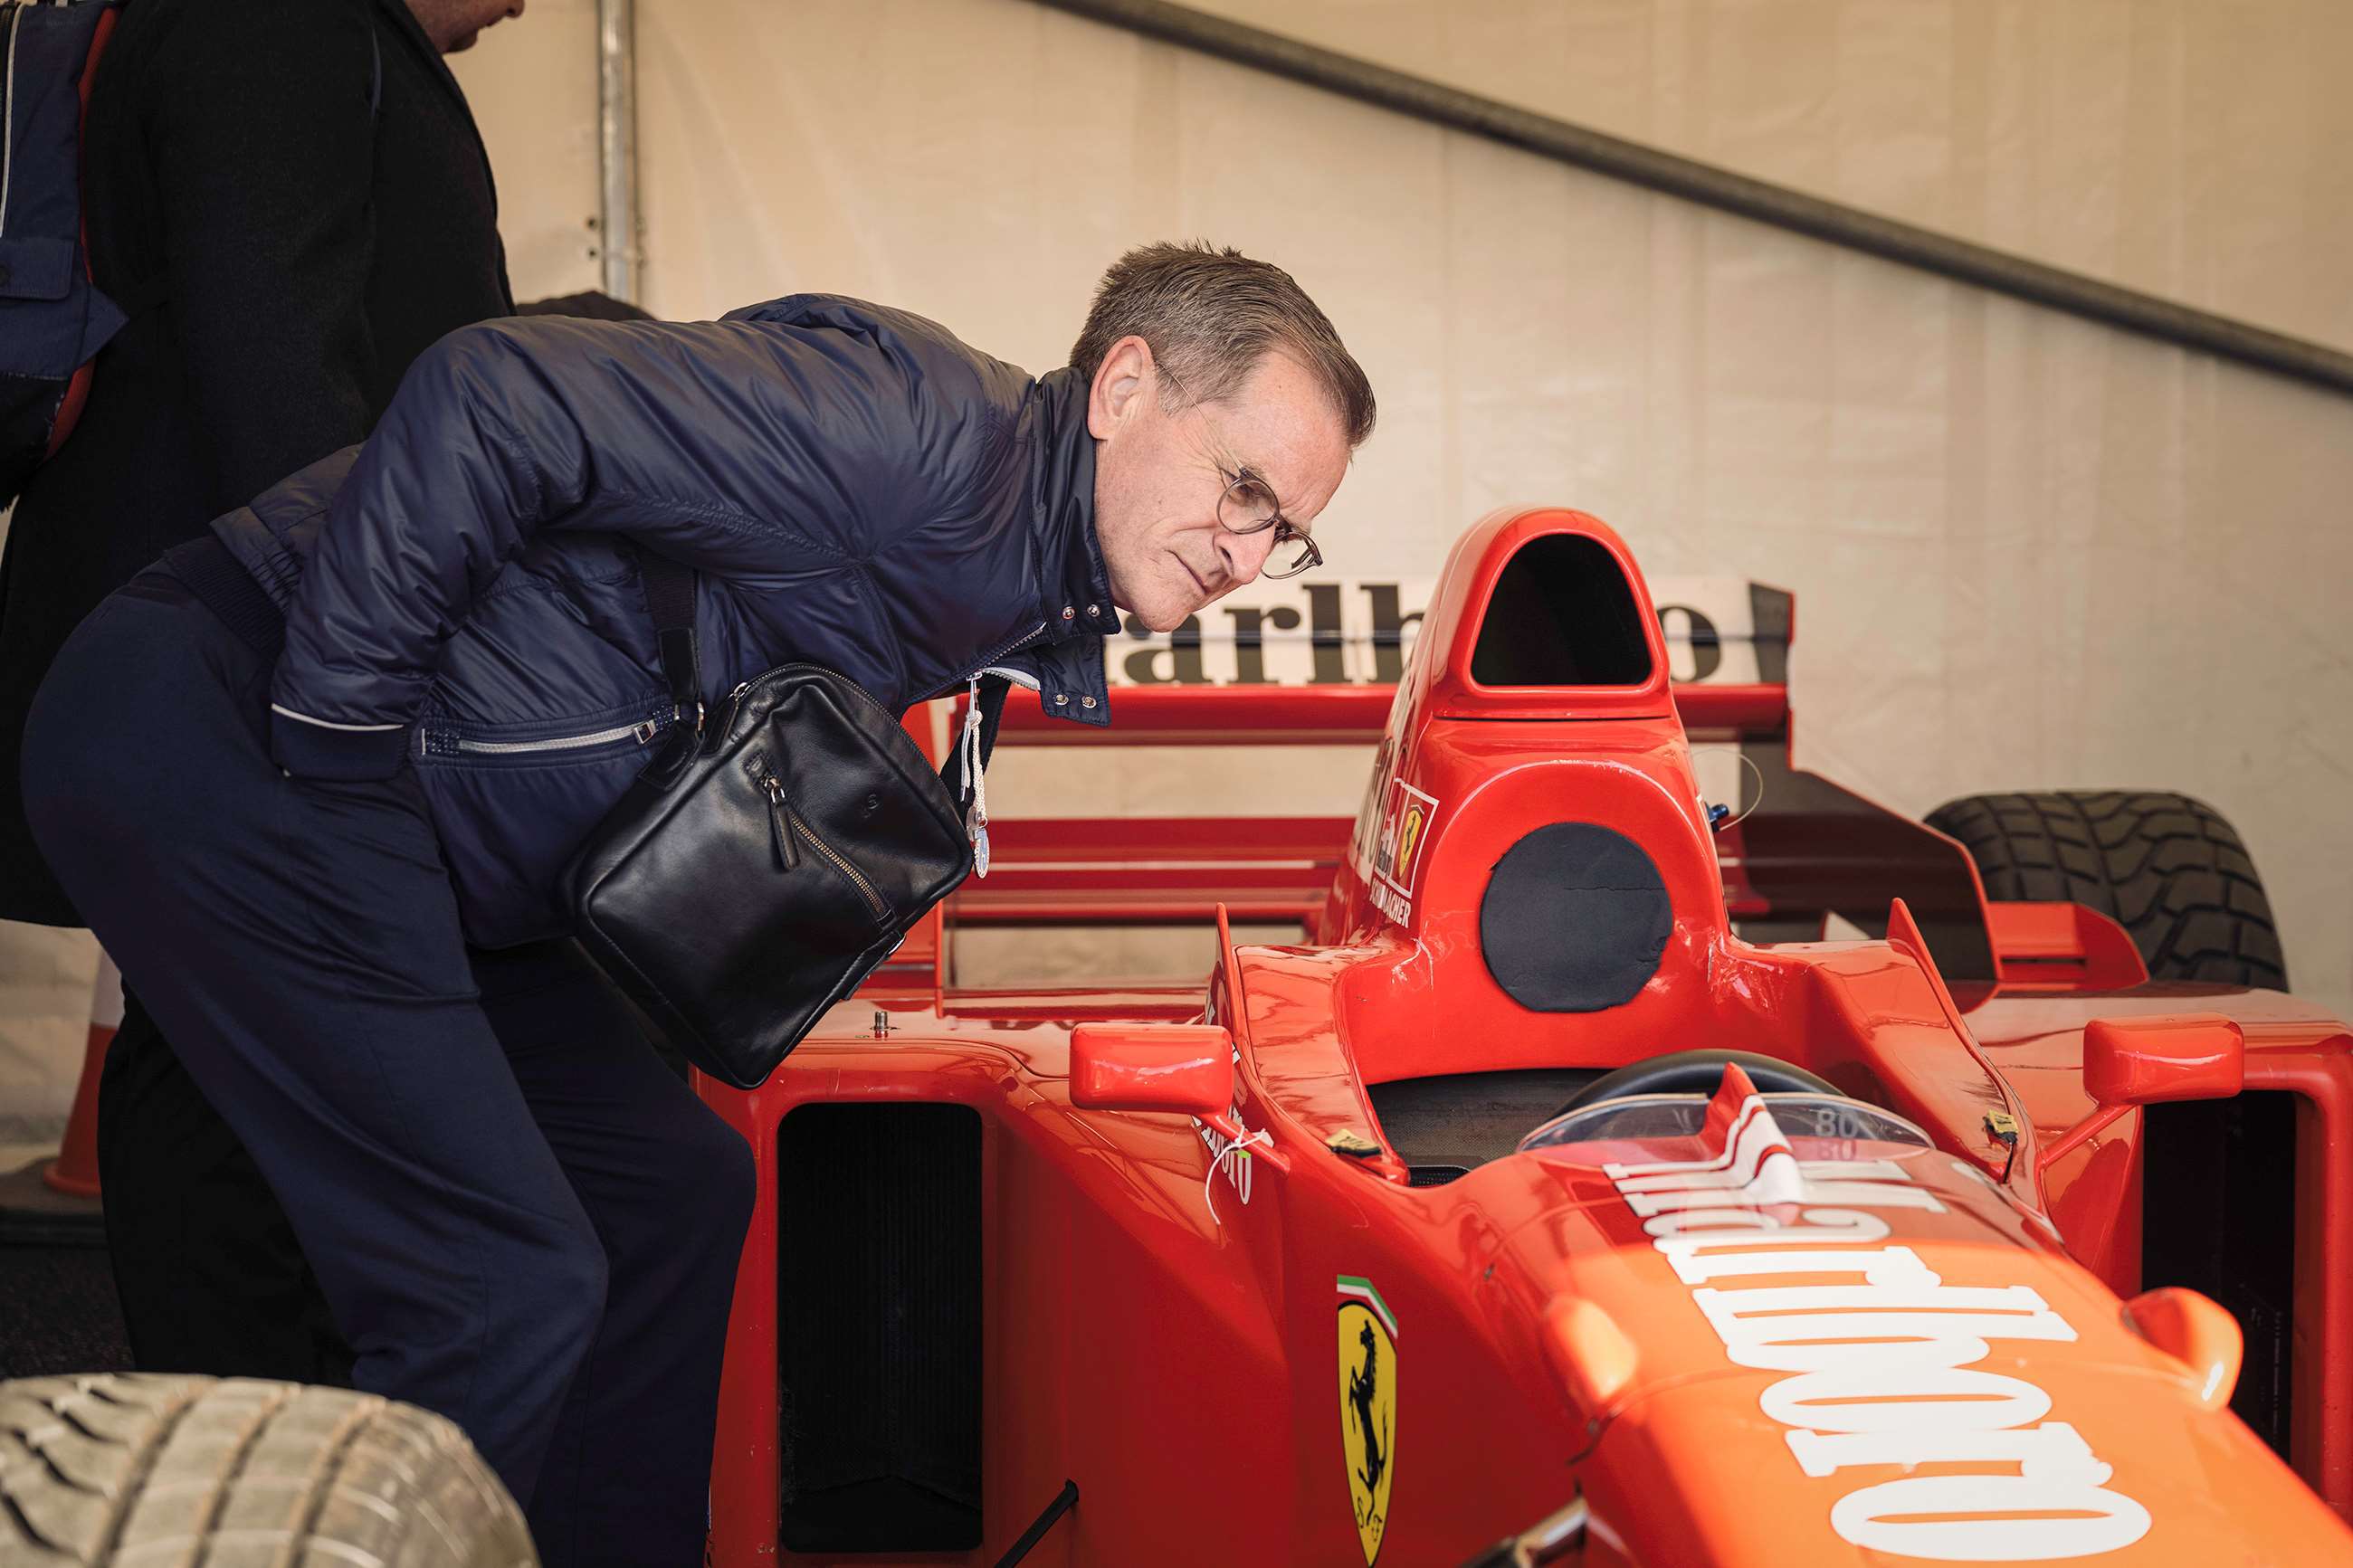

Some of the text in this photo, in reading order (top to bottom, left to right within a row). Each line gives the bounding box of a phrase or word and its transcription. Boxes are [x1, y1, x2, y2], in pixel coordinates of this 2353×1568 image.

[1109, 584, 1721, 684] arlbo
[1815, 1107, 1858, 1138] 80
[1601, 1093, 2152, 1562] Marlboro
